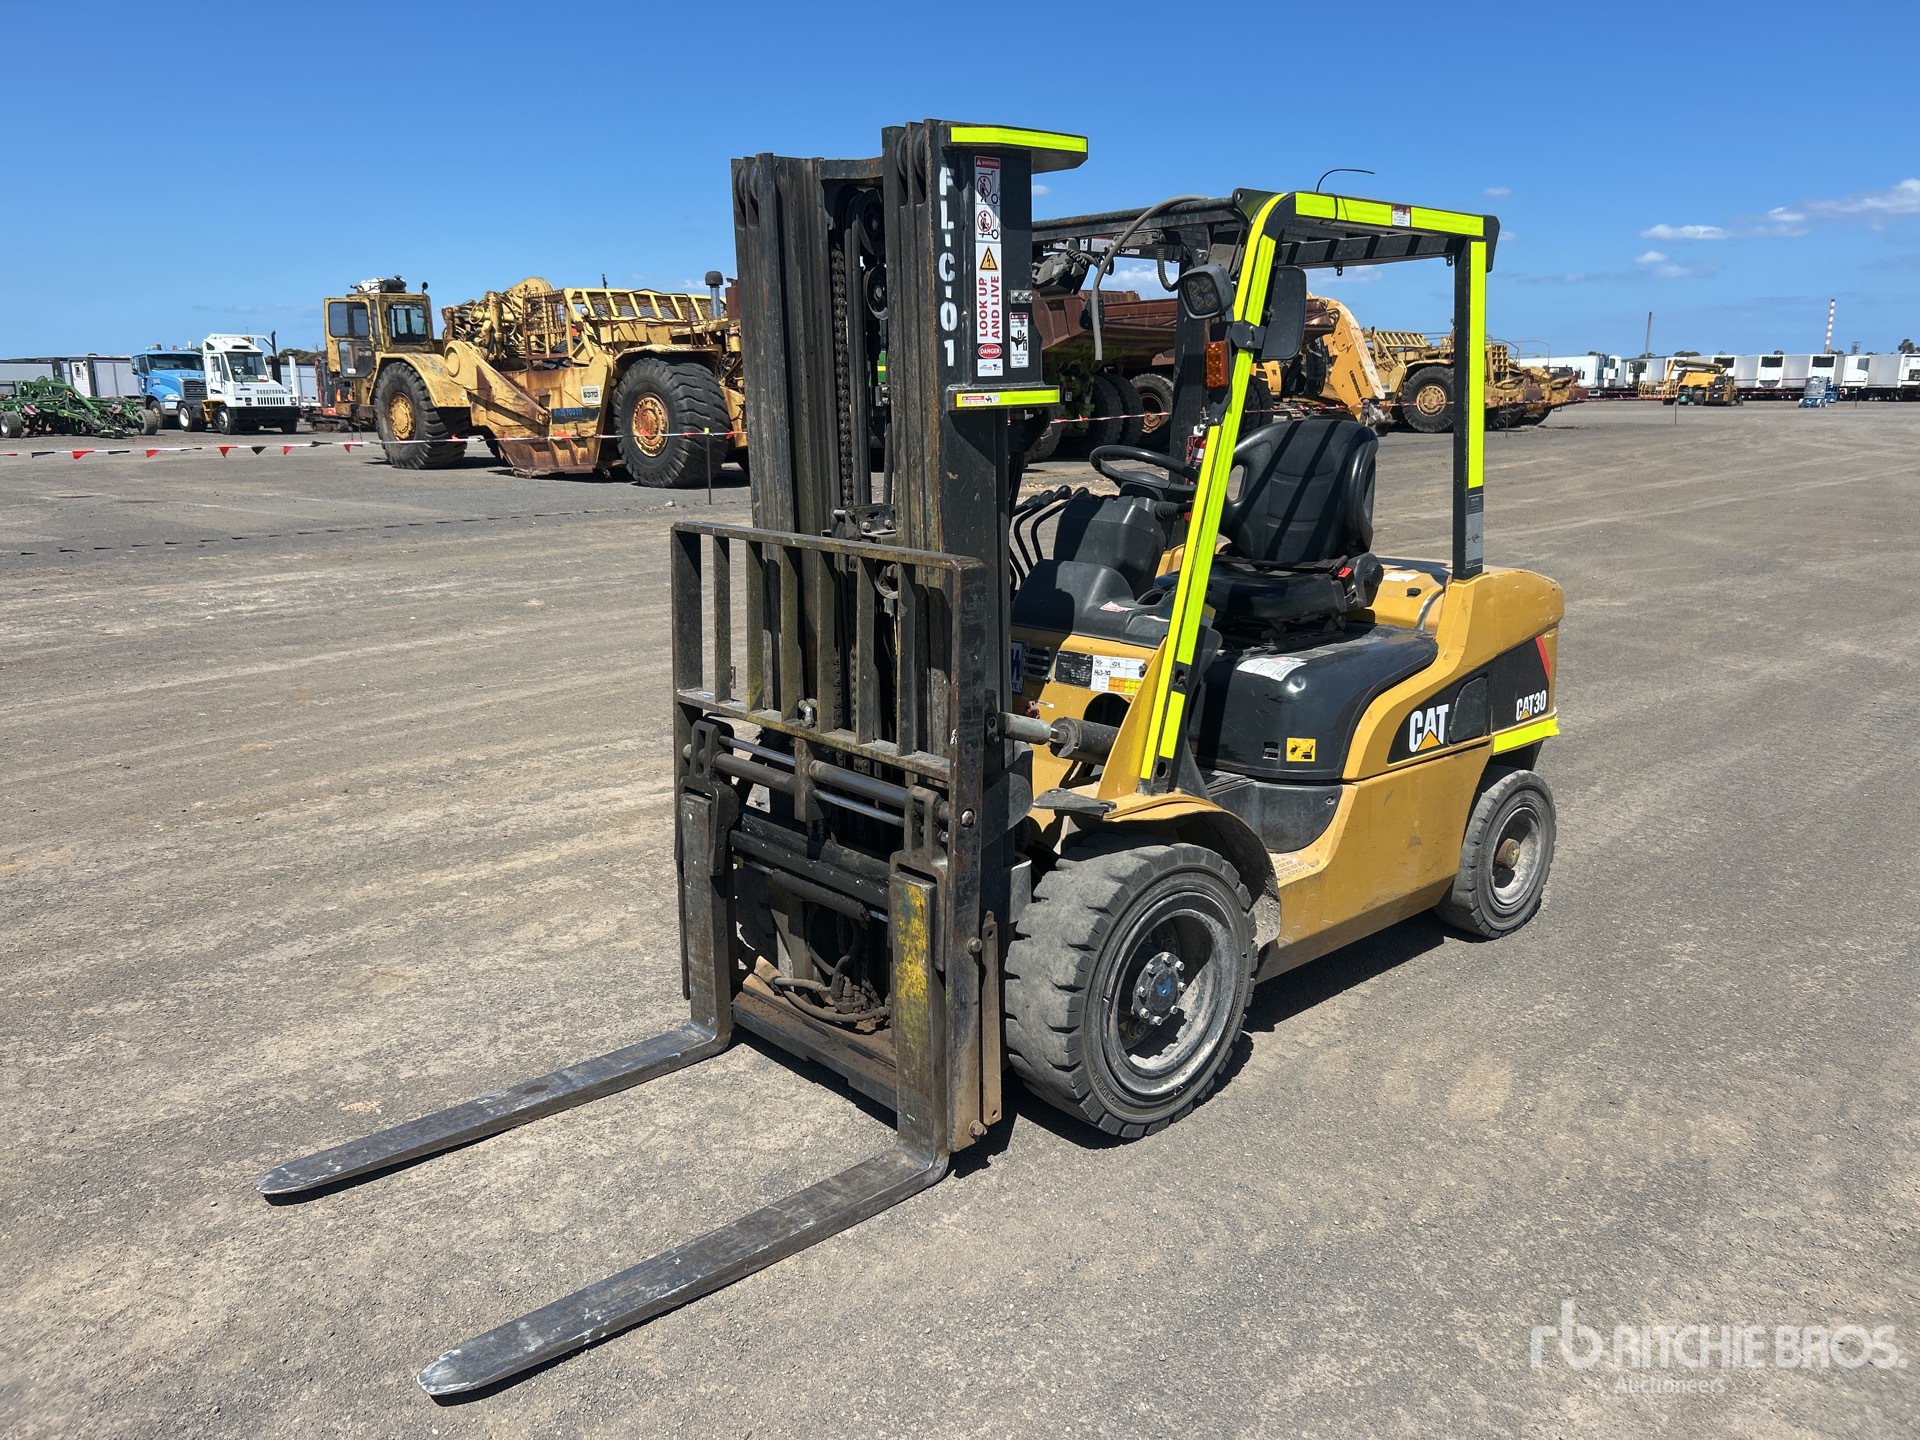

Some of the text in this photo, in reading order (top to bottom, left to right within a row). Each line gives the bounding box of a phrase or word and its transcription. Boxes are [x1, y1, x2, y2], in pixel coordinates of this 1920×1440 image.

[978, 277, 988, 337] LOOK UP
[991, 275, 1000, 340] AND LIVE
[980, 347, 1000, 355] DANGER
[1408, 703, 1450, 753] CAT
[1515, 689, 1547, 722] CAT30
